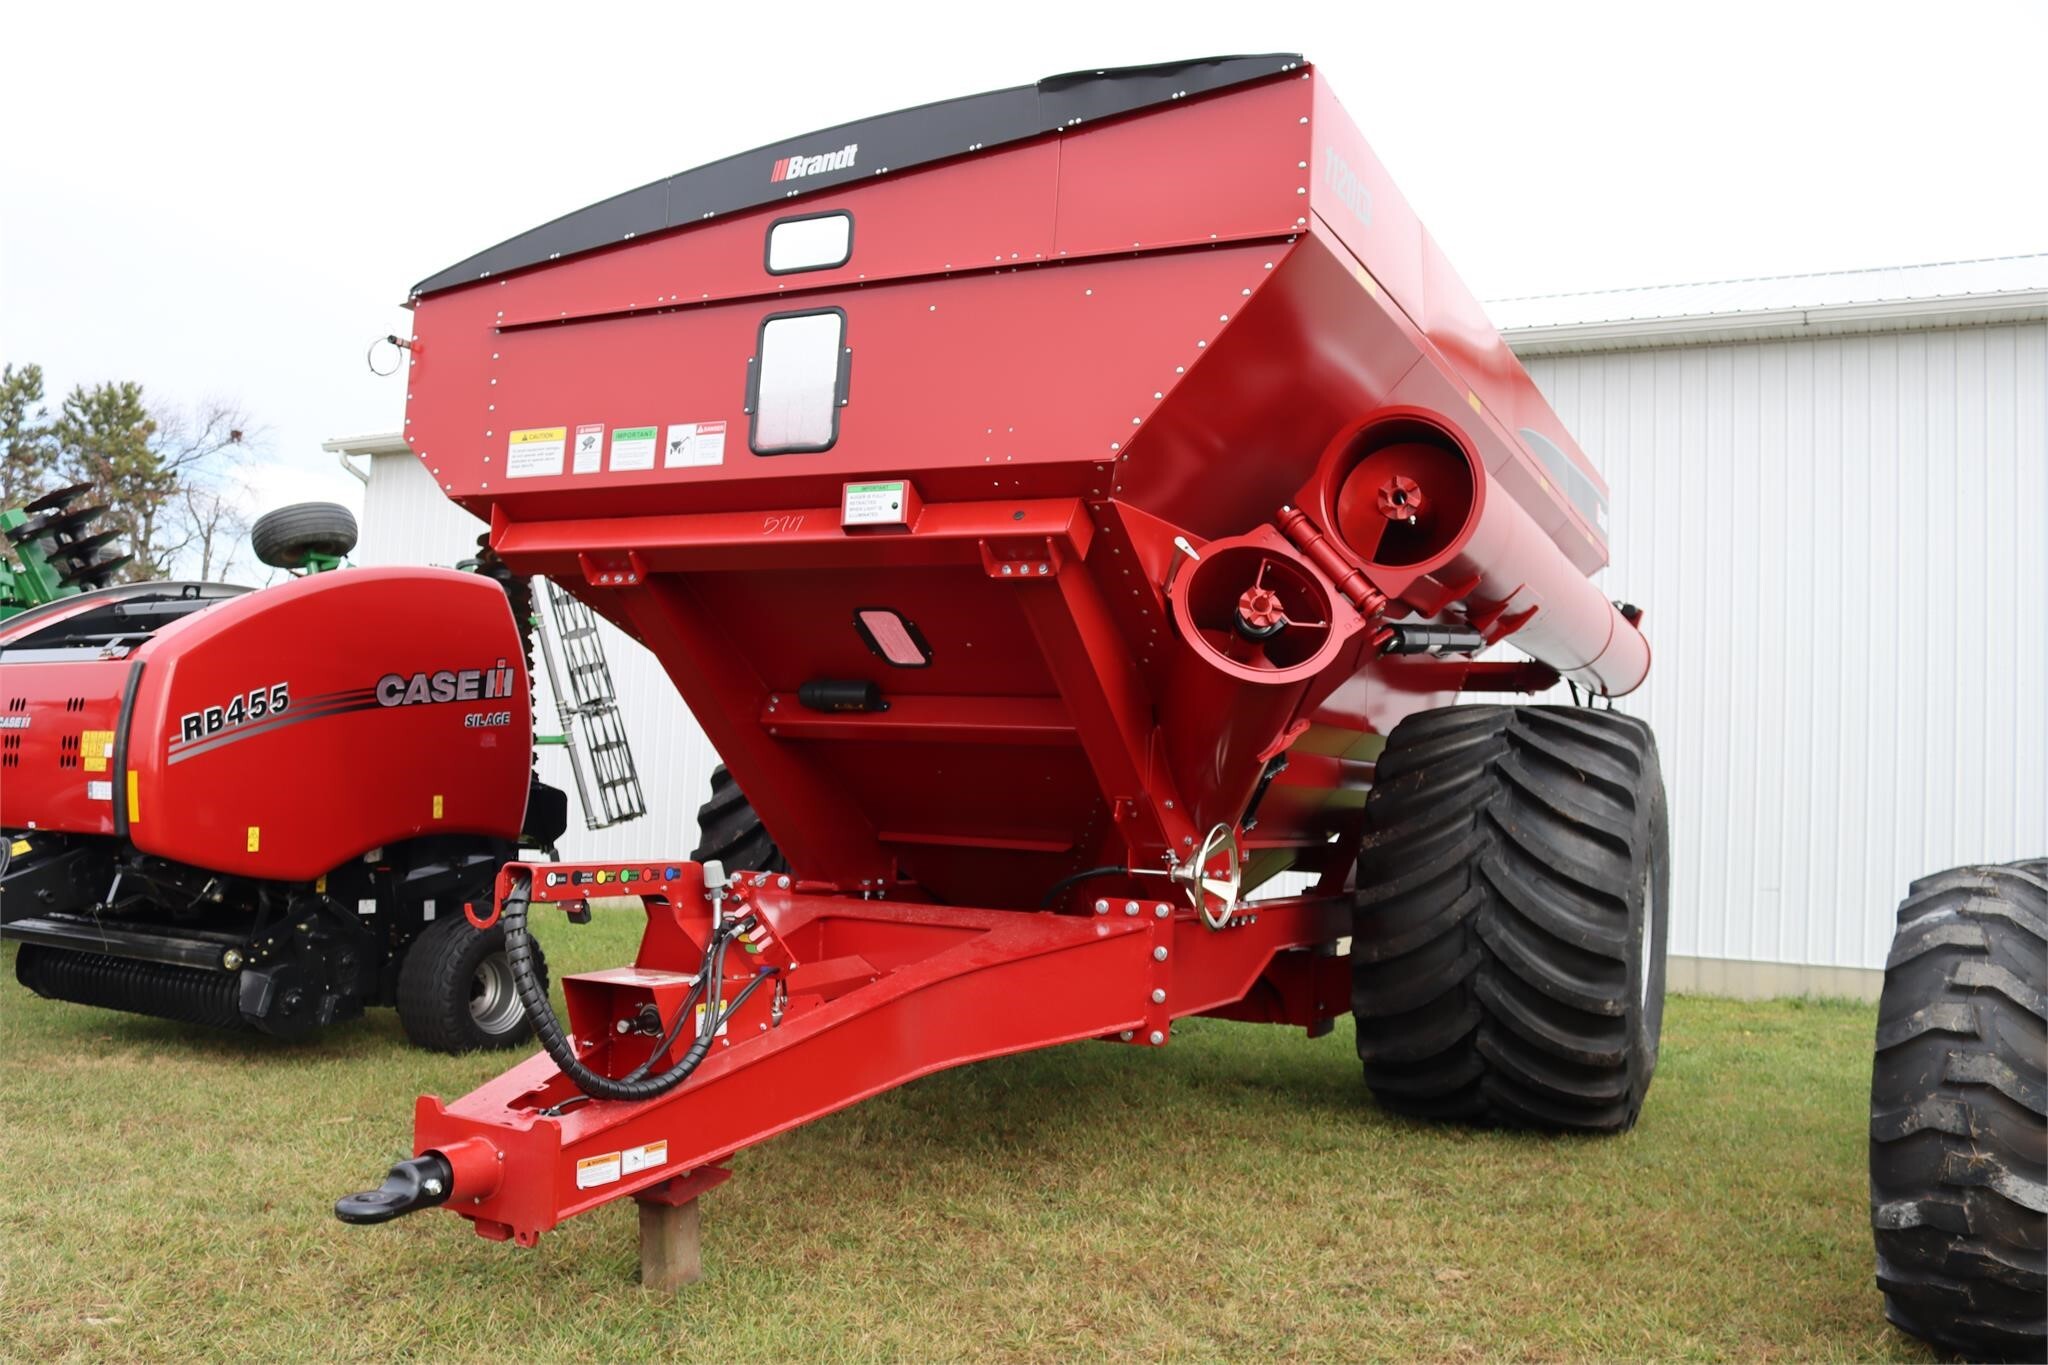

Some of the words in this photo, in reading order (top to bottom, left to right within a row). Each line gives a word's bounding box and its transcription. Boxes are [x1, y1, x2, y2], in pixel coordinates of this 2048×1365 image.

[785, 144, 858, 180] Brandt
[529, 432, 554, 441] CAUTION
[615, 430, 653, 439] IMPORTANT
[376, 670, 481, 706] CASE
[181, 682, 289, 743] RB455
[464, 712, 511, 728] SILAGE
